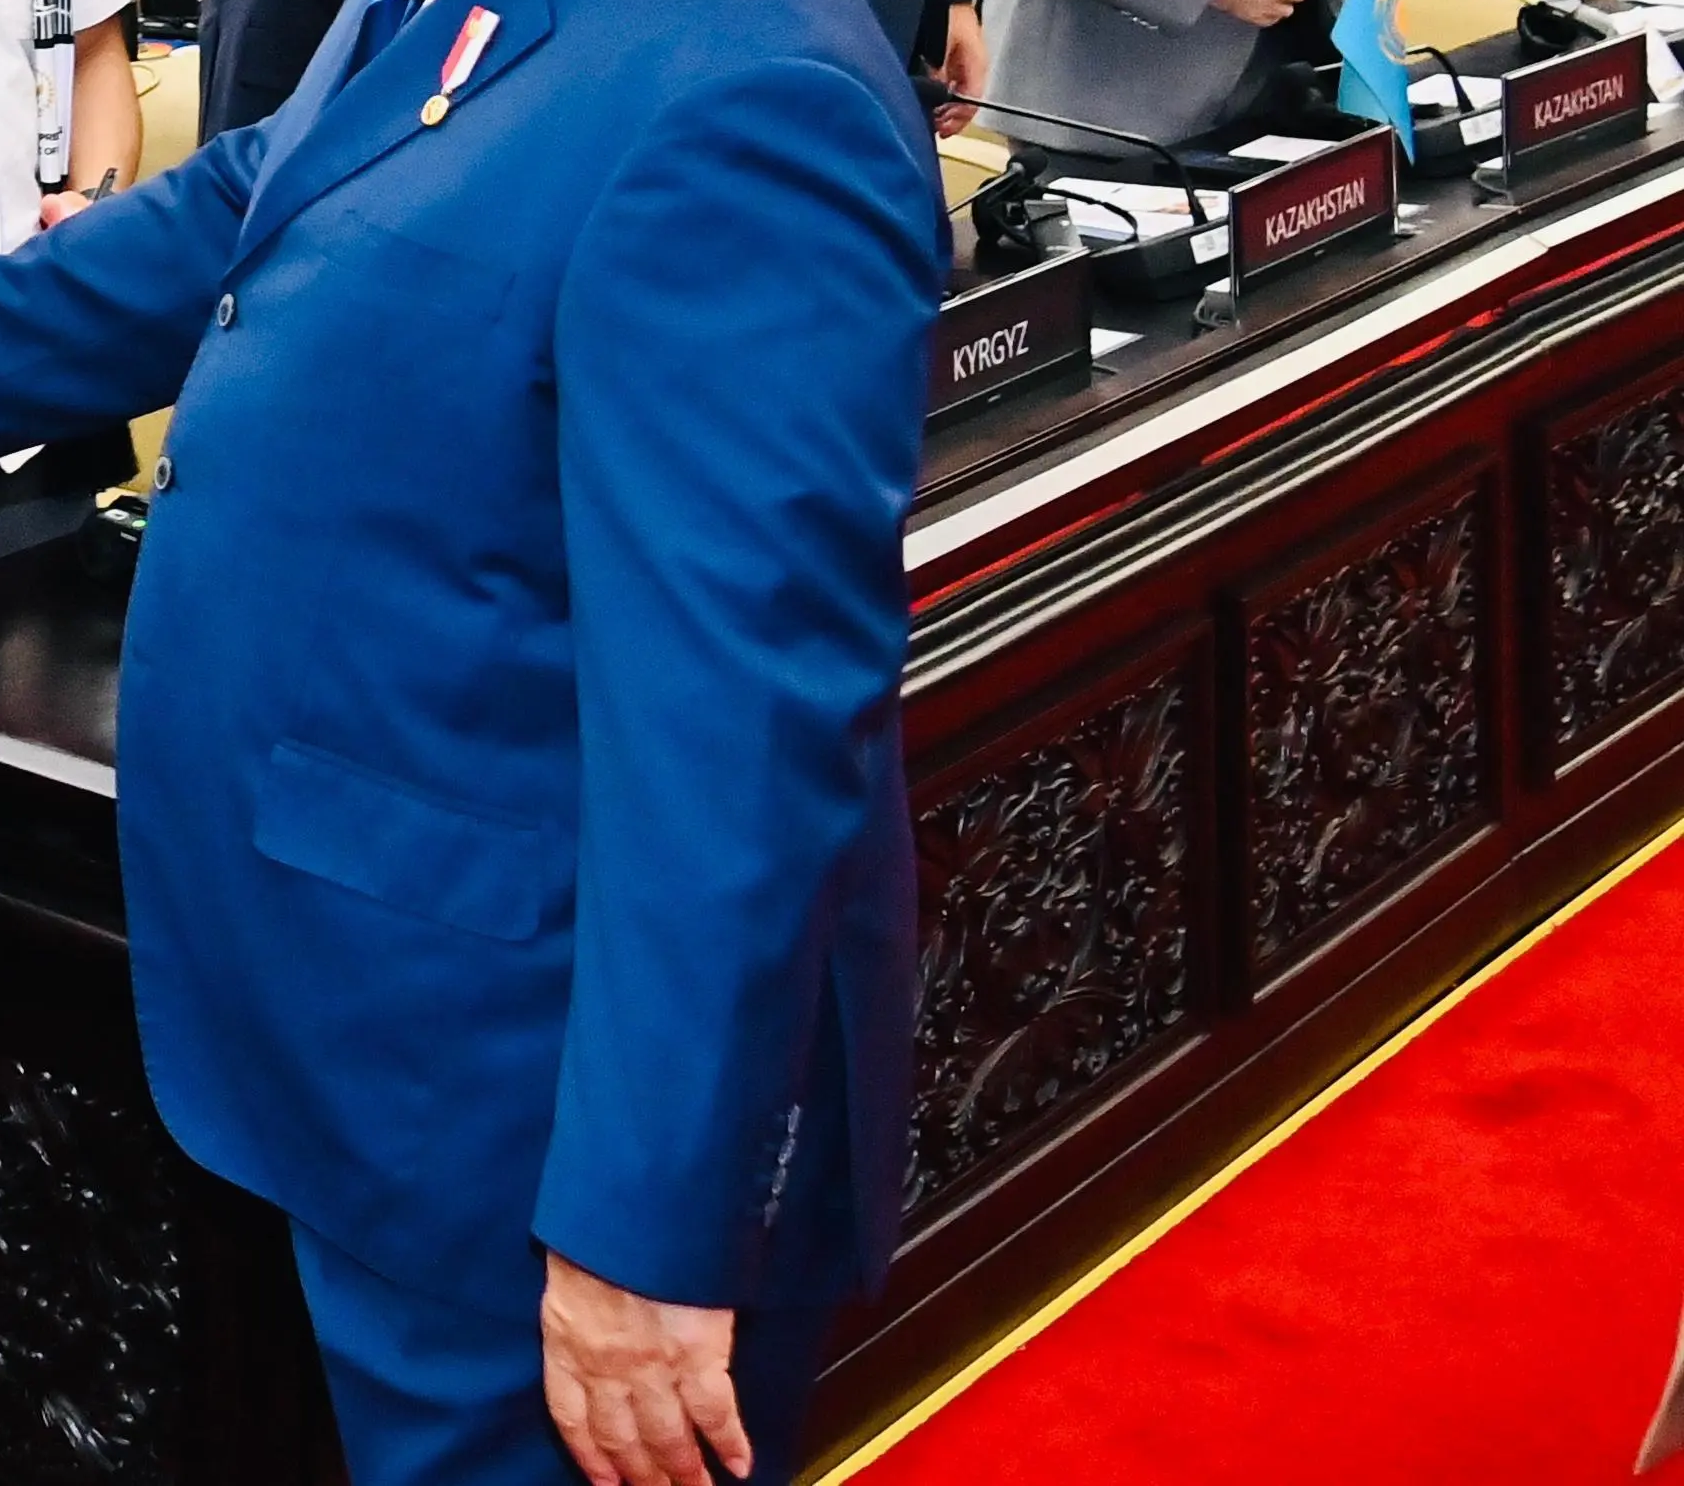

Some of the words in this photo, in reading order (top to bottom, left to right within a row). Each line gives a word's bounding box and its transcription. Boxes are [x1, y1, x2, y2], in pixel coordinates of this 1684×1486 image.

[1534, 74, 1624, 130] KAZAKHSTAN
[1265, 177, 1365, 247] KAZAKHSTAN
[953, 320, 1029, 382] KYRGYZ
